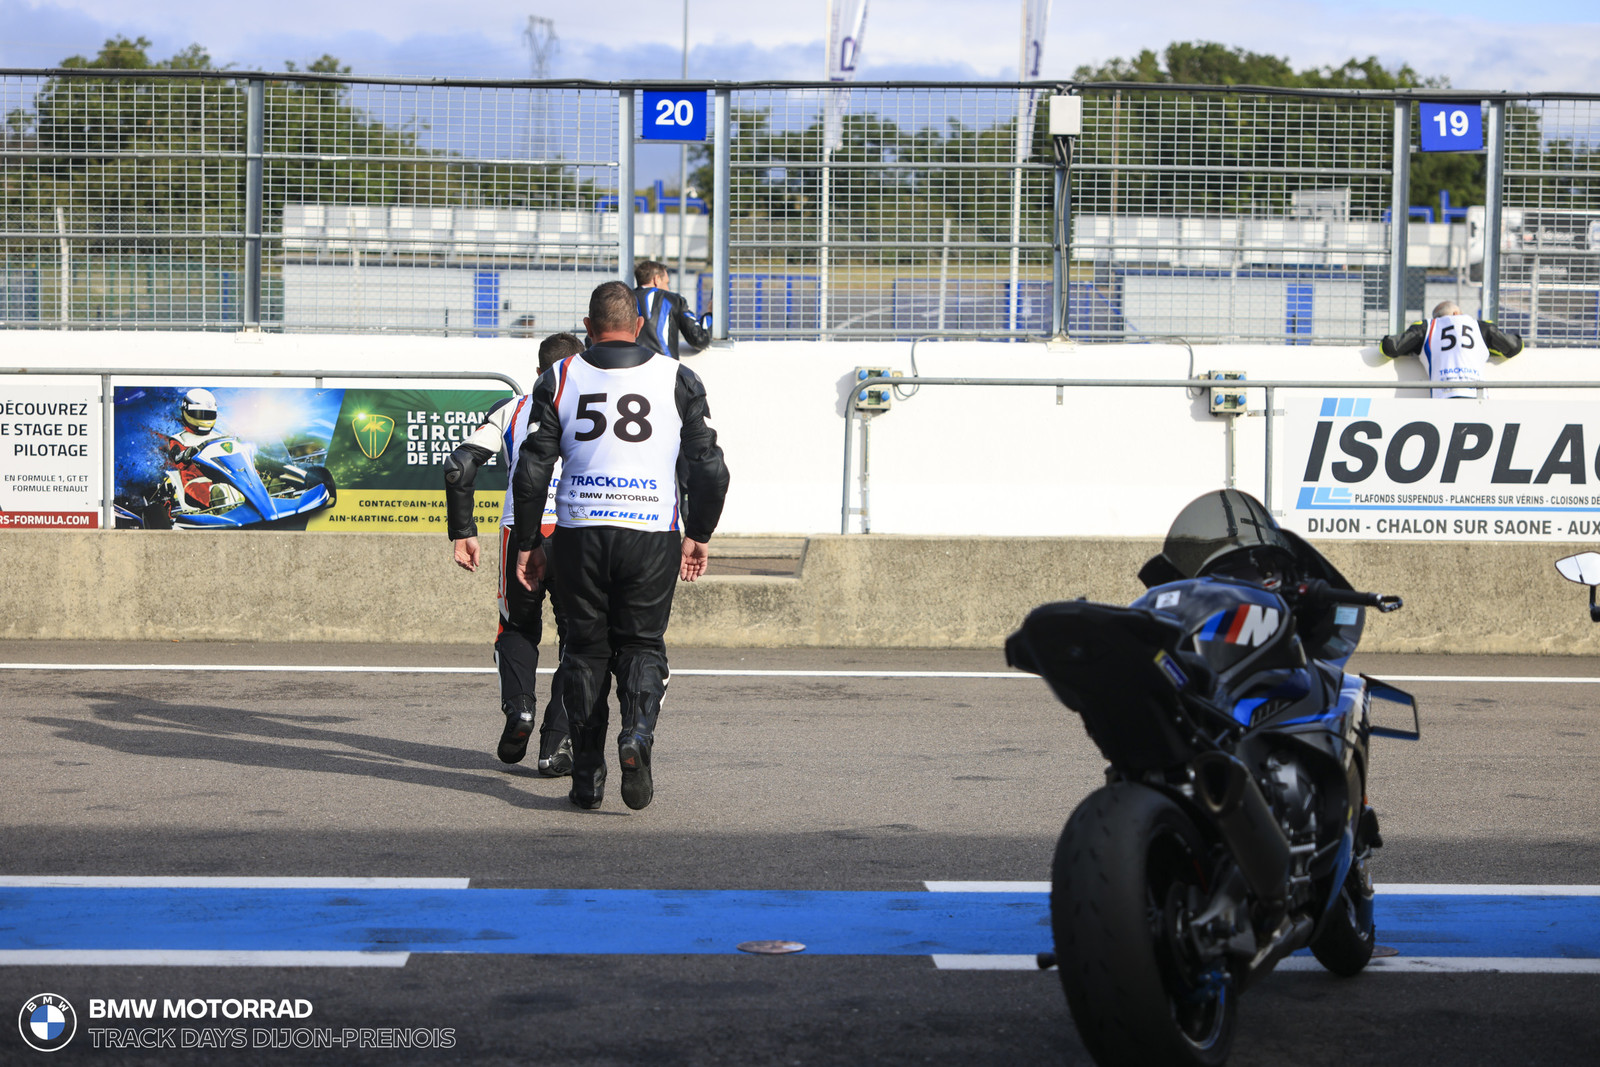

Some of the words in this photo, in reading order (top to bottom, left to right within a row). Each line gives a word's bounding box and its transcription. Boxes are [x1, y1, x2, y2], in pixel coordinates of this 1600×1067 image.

[655, 99, 694, 126] 20
[1433, 110, 1469, 137] 19
[1440, 325, 1475, 352] 55
[407, 411, 426, 424] LE
[444, 411, 489, 424] GRAN
[574, 393, 653, 443] 58
[14, 423, 63, 436] STAGE
[68, 424, 88, 436] DE
[407, 425, 476, 441] CIRCU
[14, 444, 88, 457] PILOTAGE
[407, 441, 426, 452] DE
[1303, 420, 1600, 485] ISOPLA
[407, 452, 429, 465] DE
[58, 475, 65, 483] 1,
[571, 475, 657, 490] TRACKDAYS
[358, 499, 499, 508] CONTACT@AIN-KA.COM
[605, 493, 659, 503] MOTORRAD
[1354, 494, 1396, 503] PLAFONDS
[1397, 494, 1444, 504] SUSPENDUS
[1450, 495, 1496, 504] PLANCHERS
[1498, 495, 1514, 504] SUR
[1550, 496, 1589, 505] CLOISONS
[328, 514, 418, 522] AIN-KARTING.COM
[589, 509, 659, 521] MICHELIN
[1308, 518, 1360, 533] DIJON
[1376, 518, 1447, 533] CHALON
[1453, 519, 1488, 534] SUR
[1494, 520, 1552, 534] SAONE
[1235, 604, 1279, 648] M
